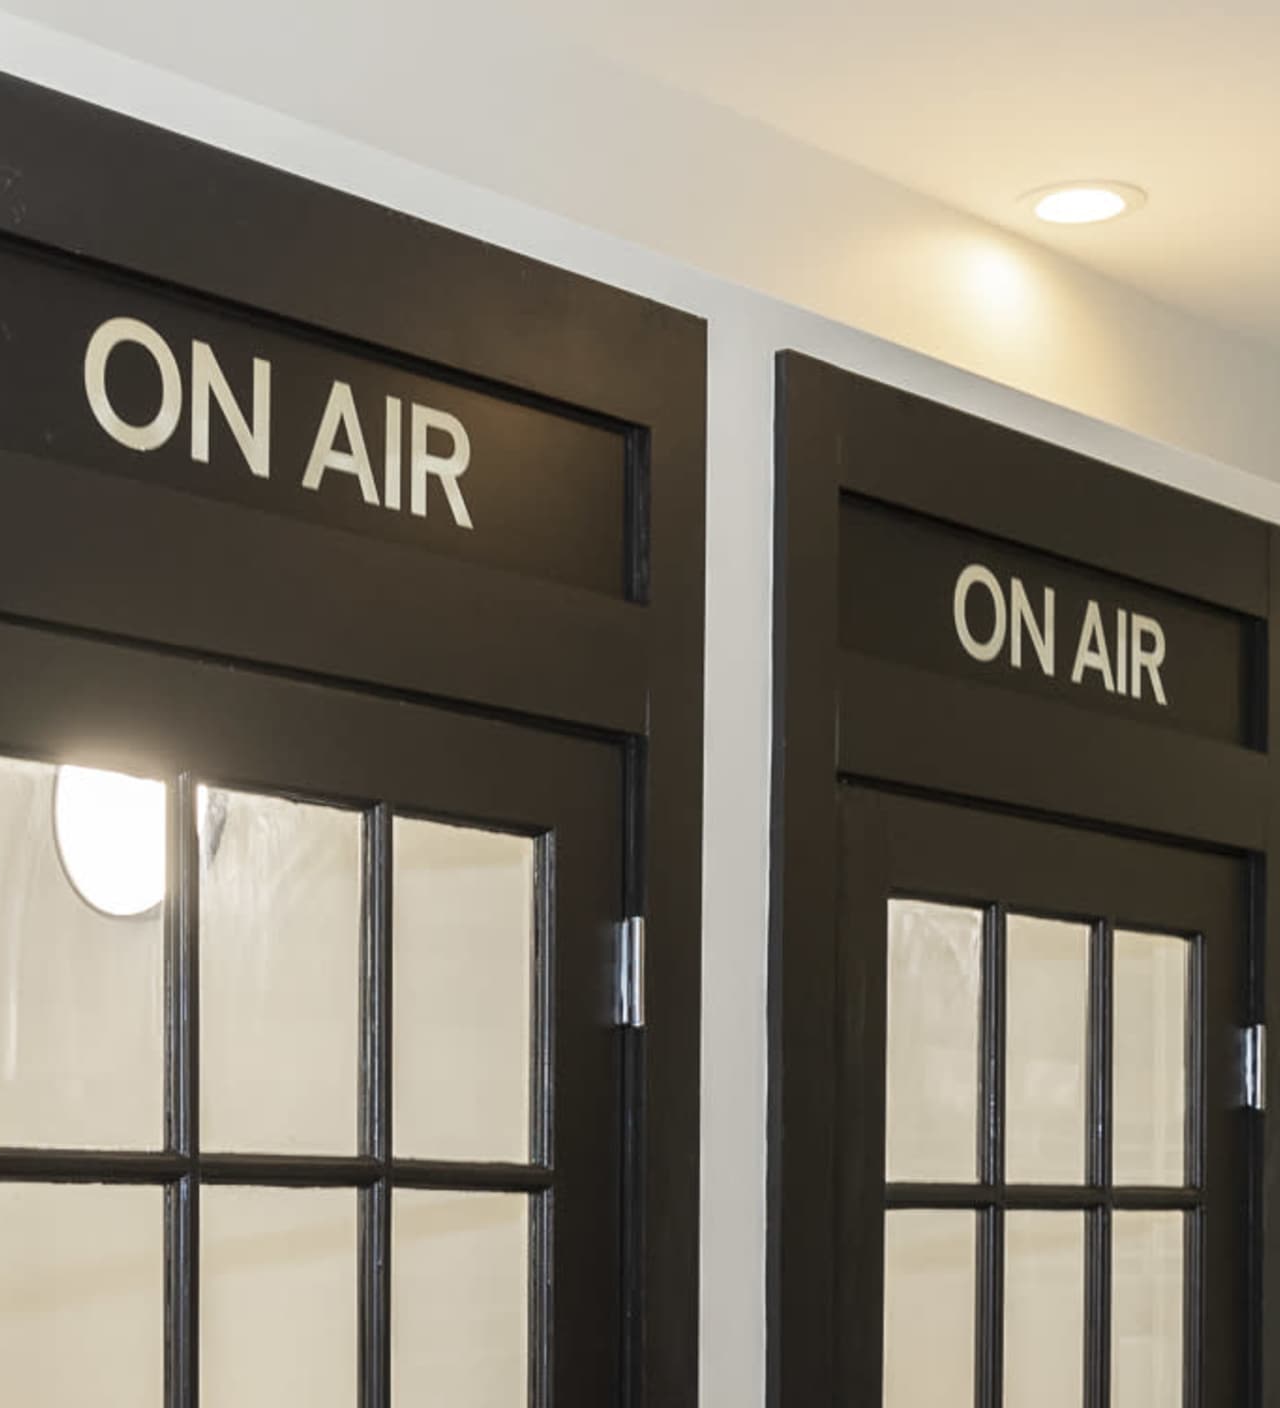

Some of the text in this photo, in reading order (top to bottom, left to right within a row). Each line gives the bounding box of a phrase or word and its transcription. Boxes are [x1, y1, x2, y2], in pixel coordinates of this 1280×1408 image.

[83, 316, 474, 530] ON AIR
[953, 563, 1167, 706] ON AIR
